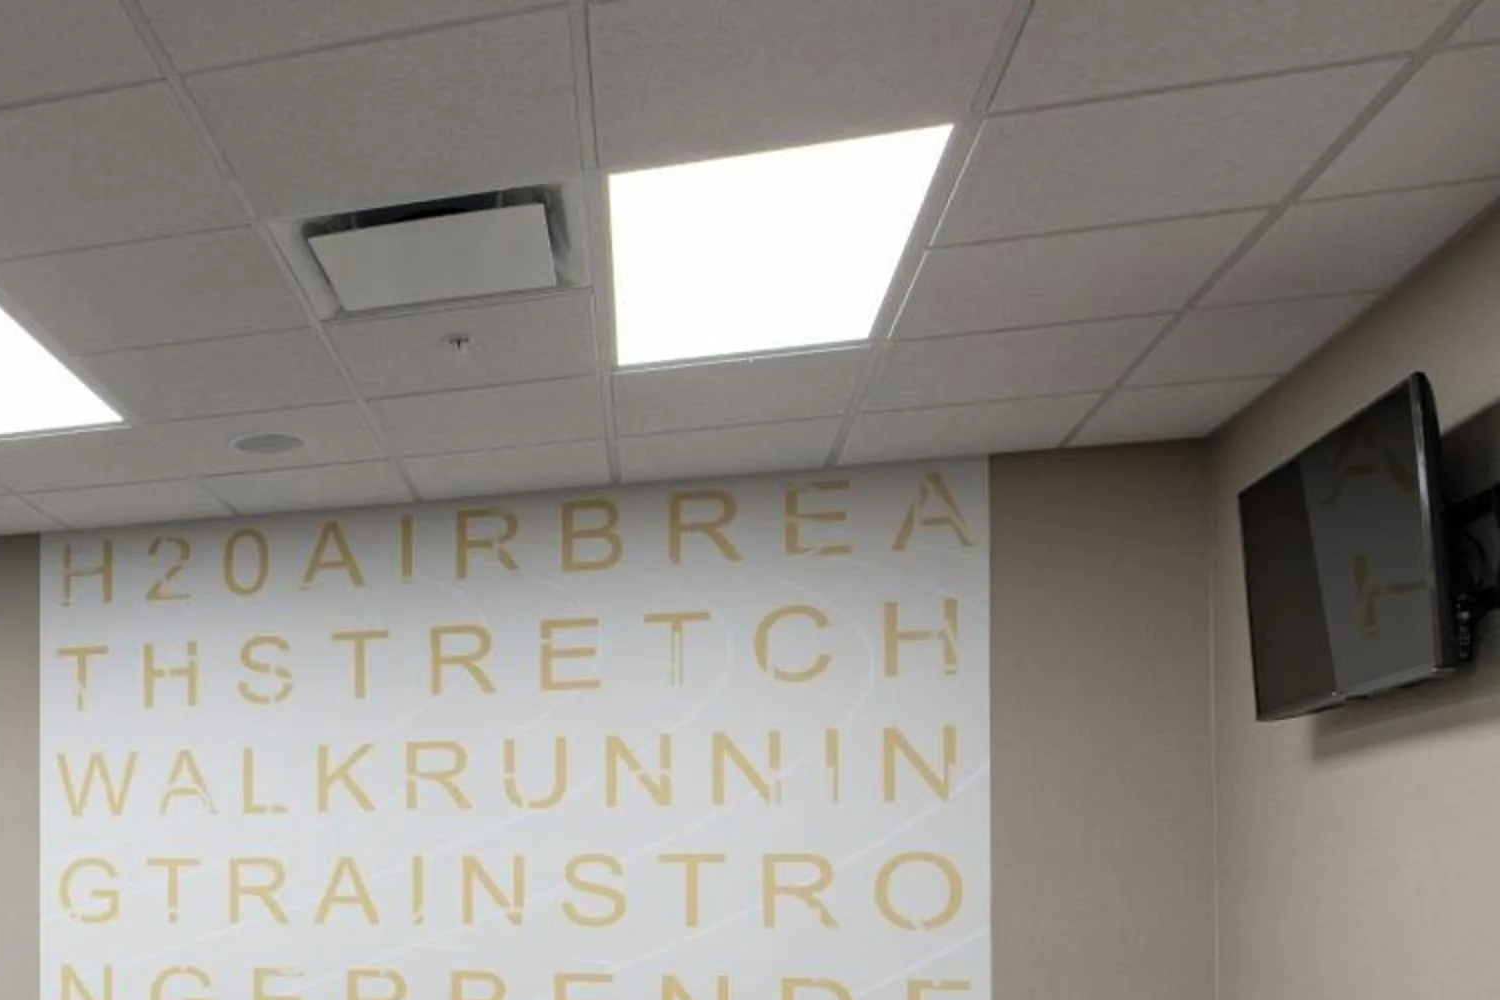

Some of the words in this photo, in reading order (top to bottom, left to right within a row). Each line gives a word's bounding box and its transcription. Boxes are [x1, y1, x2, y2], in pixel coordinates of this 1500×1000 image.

[56, 598, 959, 711] THSTRETCH
[56, 724, 959, 818] WALKRUNNIN
[57, 851, 964, 932] GTRAINSTRO
